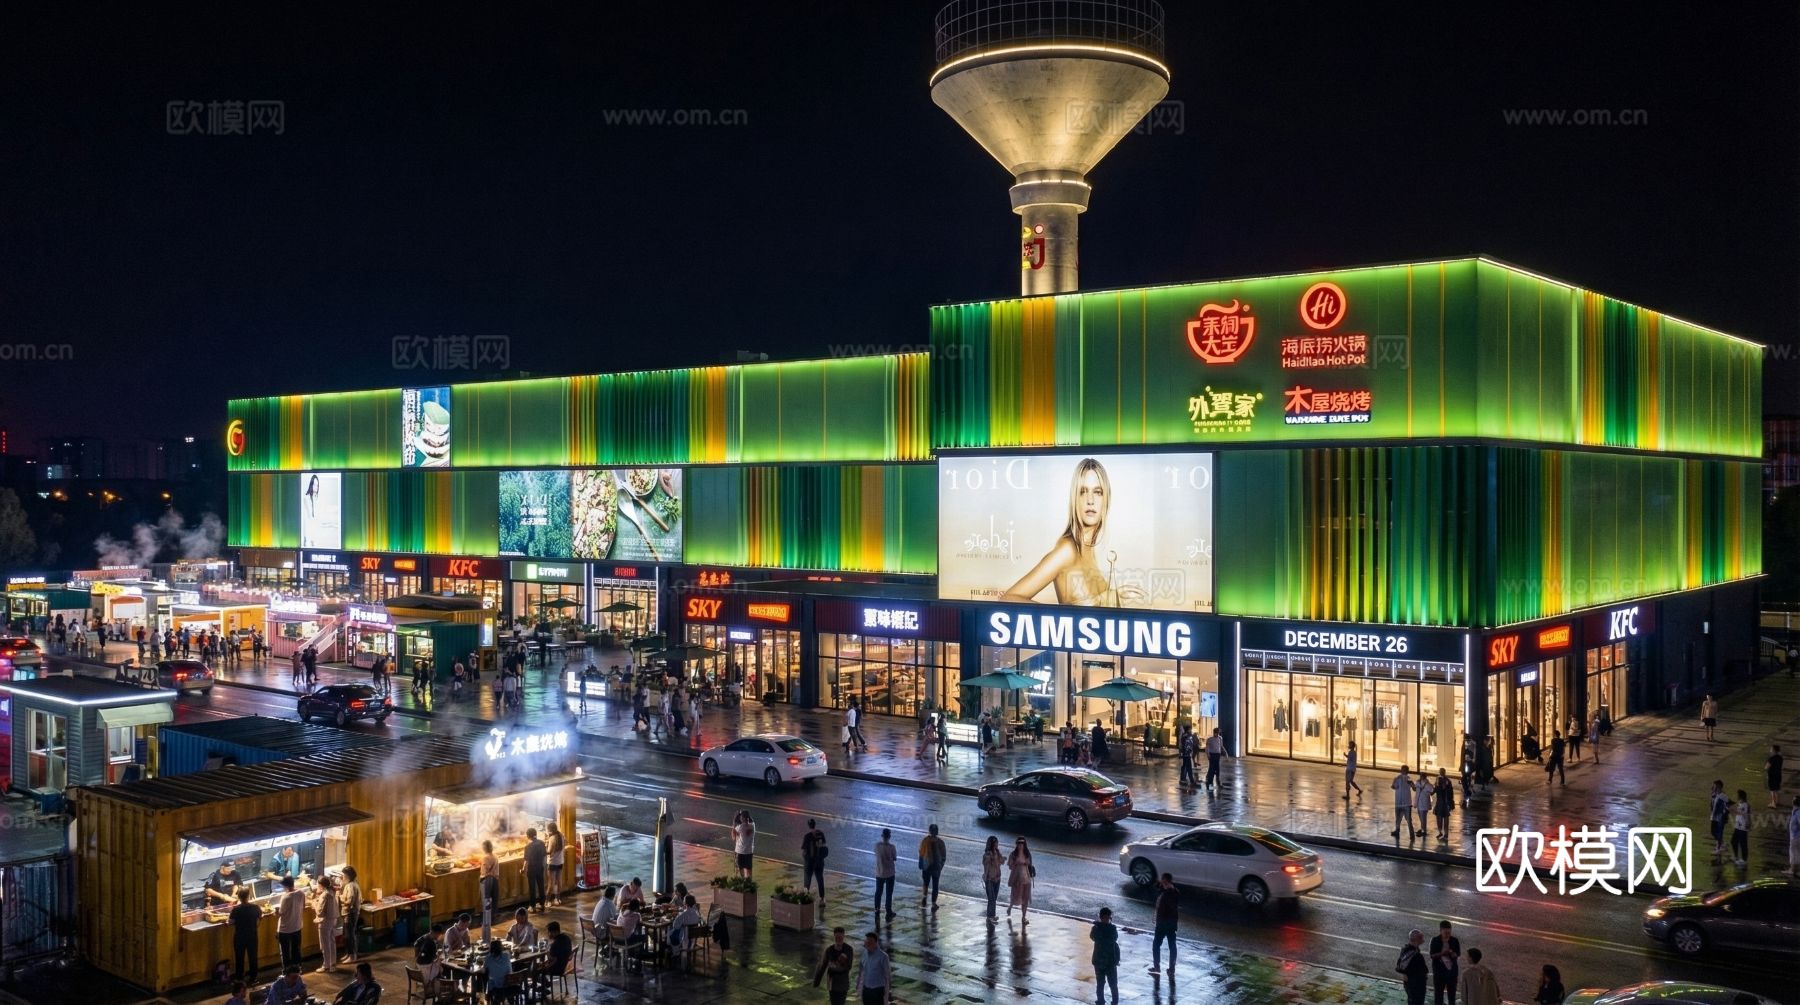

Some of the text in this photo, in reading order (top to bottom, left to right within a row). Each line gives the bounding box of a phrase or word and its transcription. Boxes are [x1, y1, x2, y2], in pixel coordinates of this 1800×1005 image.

[1281, 335, 1366, 356] 海底捞火锅
[1326, 355, 1346, 366] Hot
[1347, 353, 1367, 365] Pot
[1284, 386, 1371, 414] 木屋烧烤
[360, 558, 381, 570] SKY
[448, 559, 479, 577] KFC
[687, 599, 722, 619] SKY
[989, 611, 1193, 657] SAMSUNG
[1609, 606, 1639, 640] KFC
[1284, 630, 1408, 653] DECEMBER 26
[1490, 636, 1519, 666] SKY
